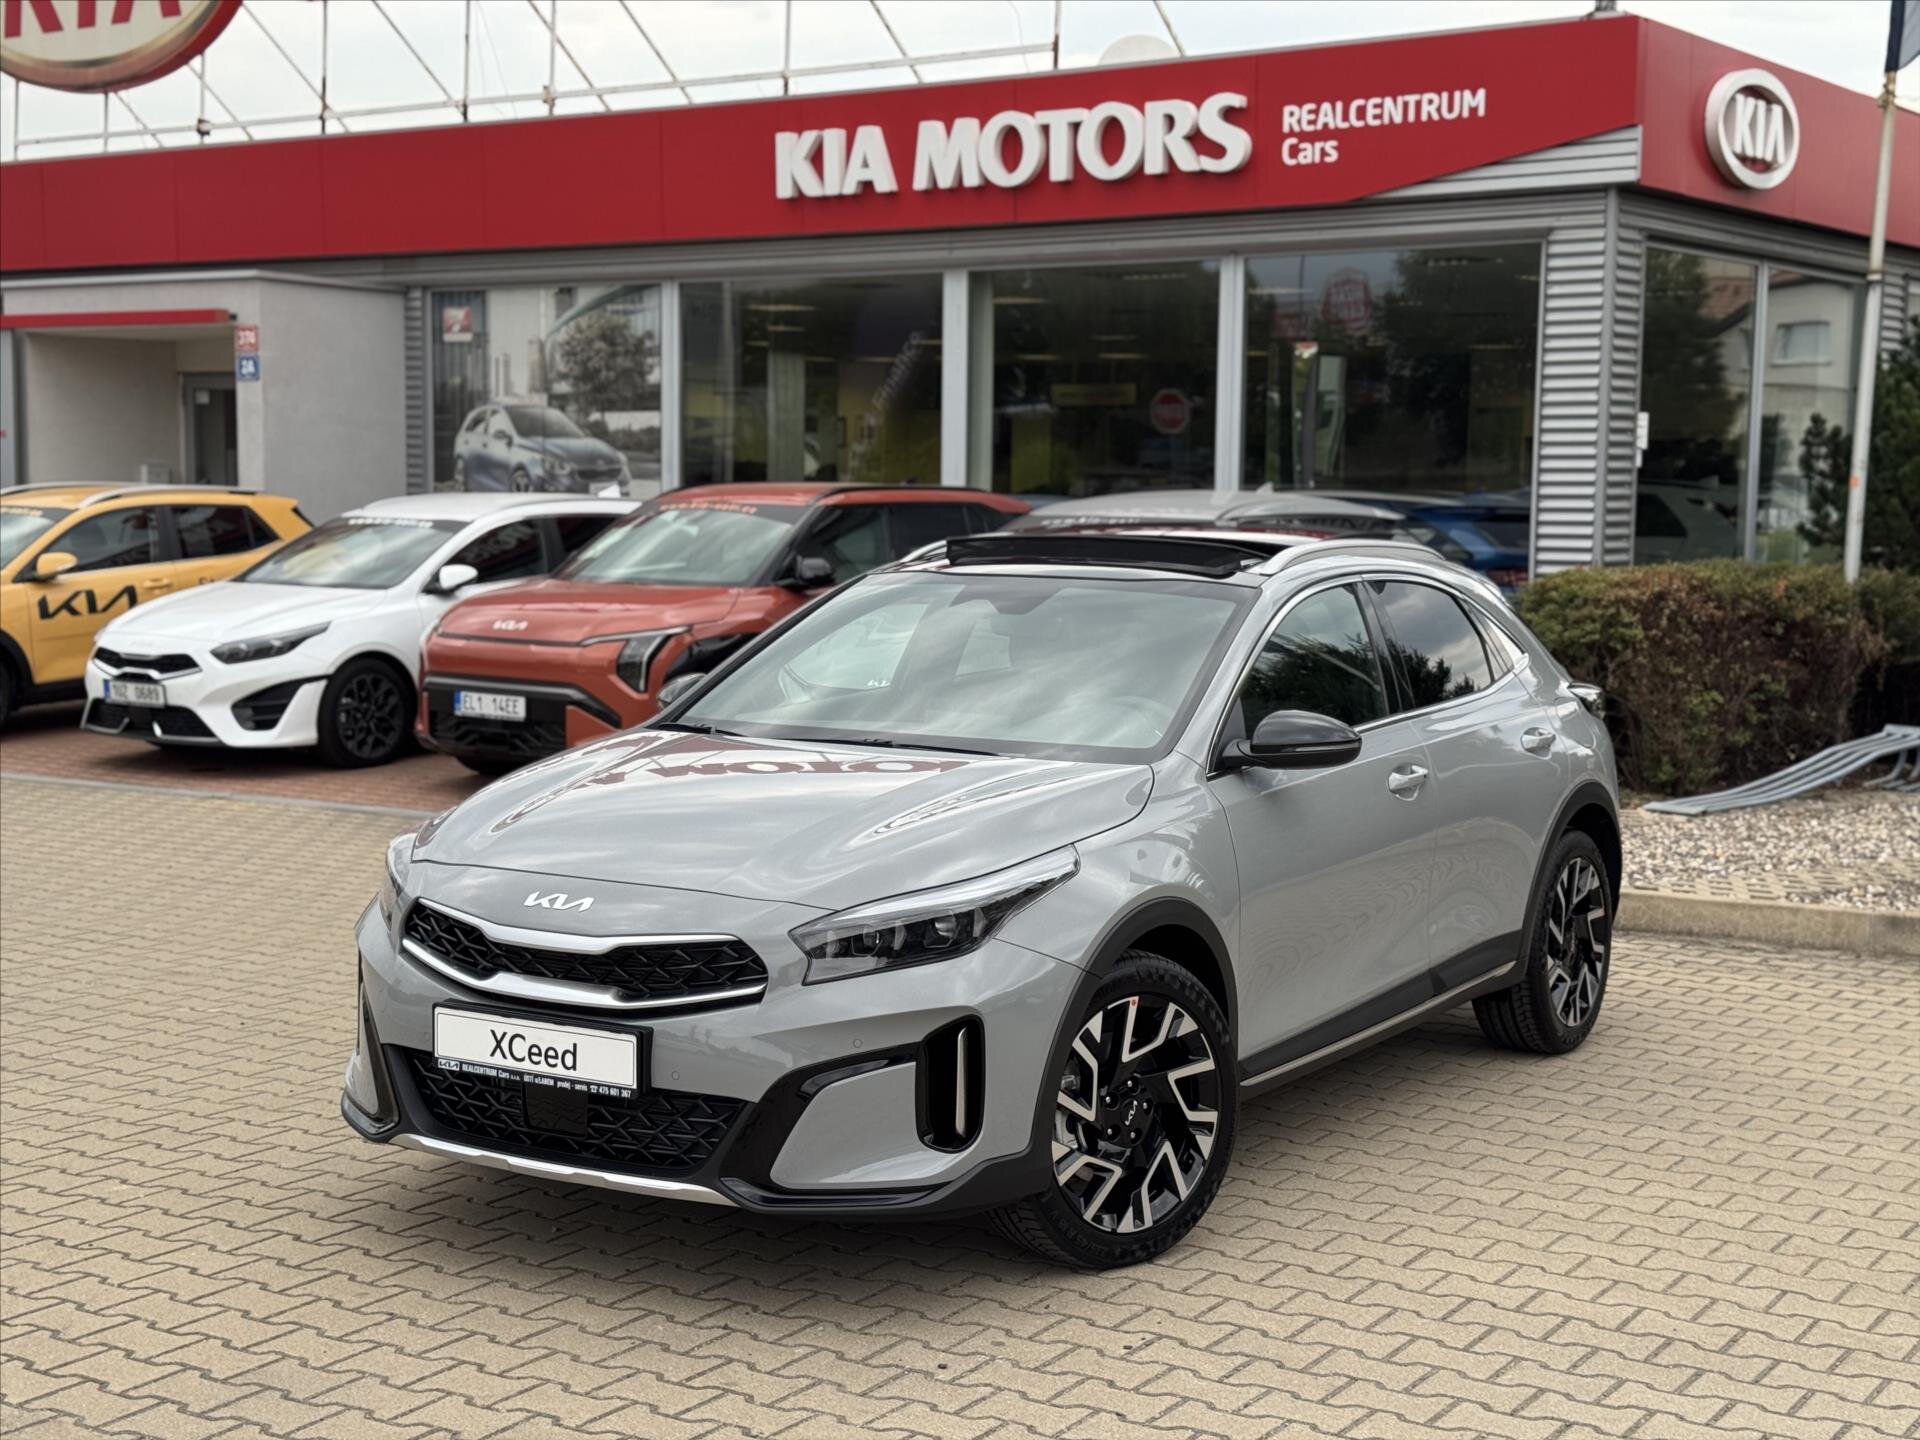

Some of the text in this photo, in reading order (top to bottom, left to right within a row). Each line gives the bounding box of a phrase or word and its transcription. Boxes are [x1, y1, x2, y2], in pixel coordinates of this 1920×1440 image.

[1281, 87, 1487, 134] REALCENTRUM
[1733, 92, 1786, 165] KIA
[775, 92, 1253, 198] KIA MOTORS
[1281, 136, 1340, 166] Cars
[37, 584, 139, 621] KIA
[523, 890, 595, 912] KIA
[462, 1063, 498, 1077] REALCENTRUM
[489, 1028, 578, 1072] XCeed
